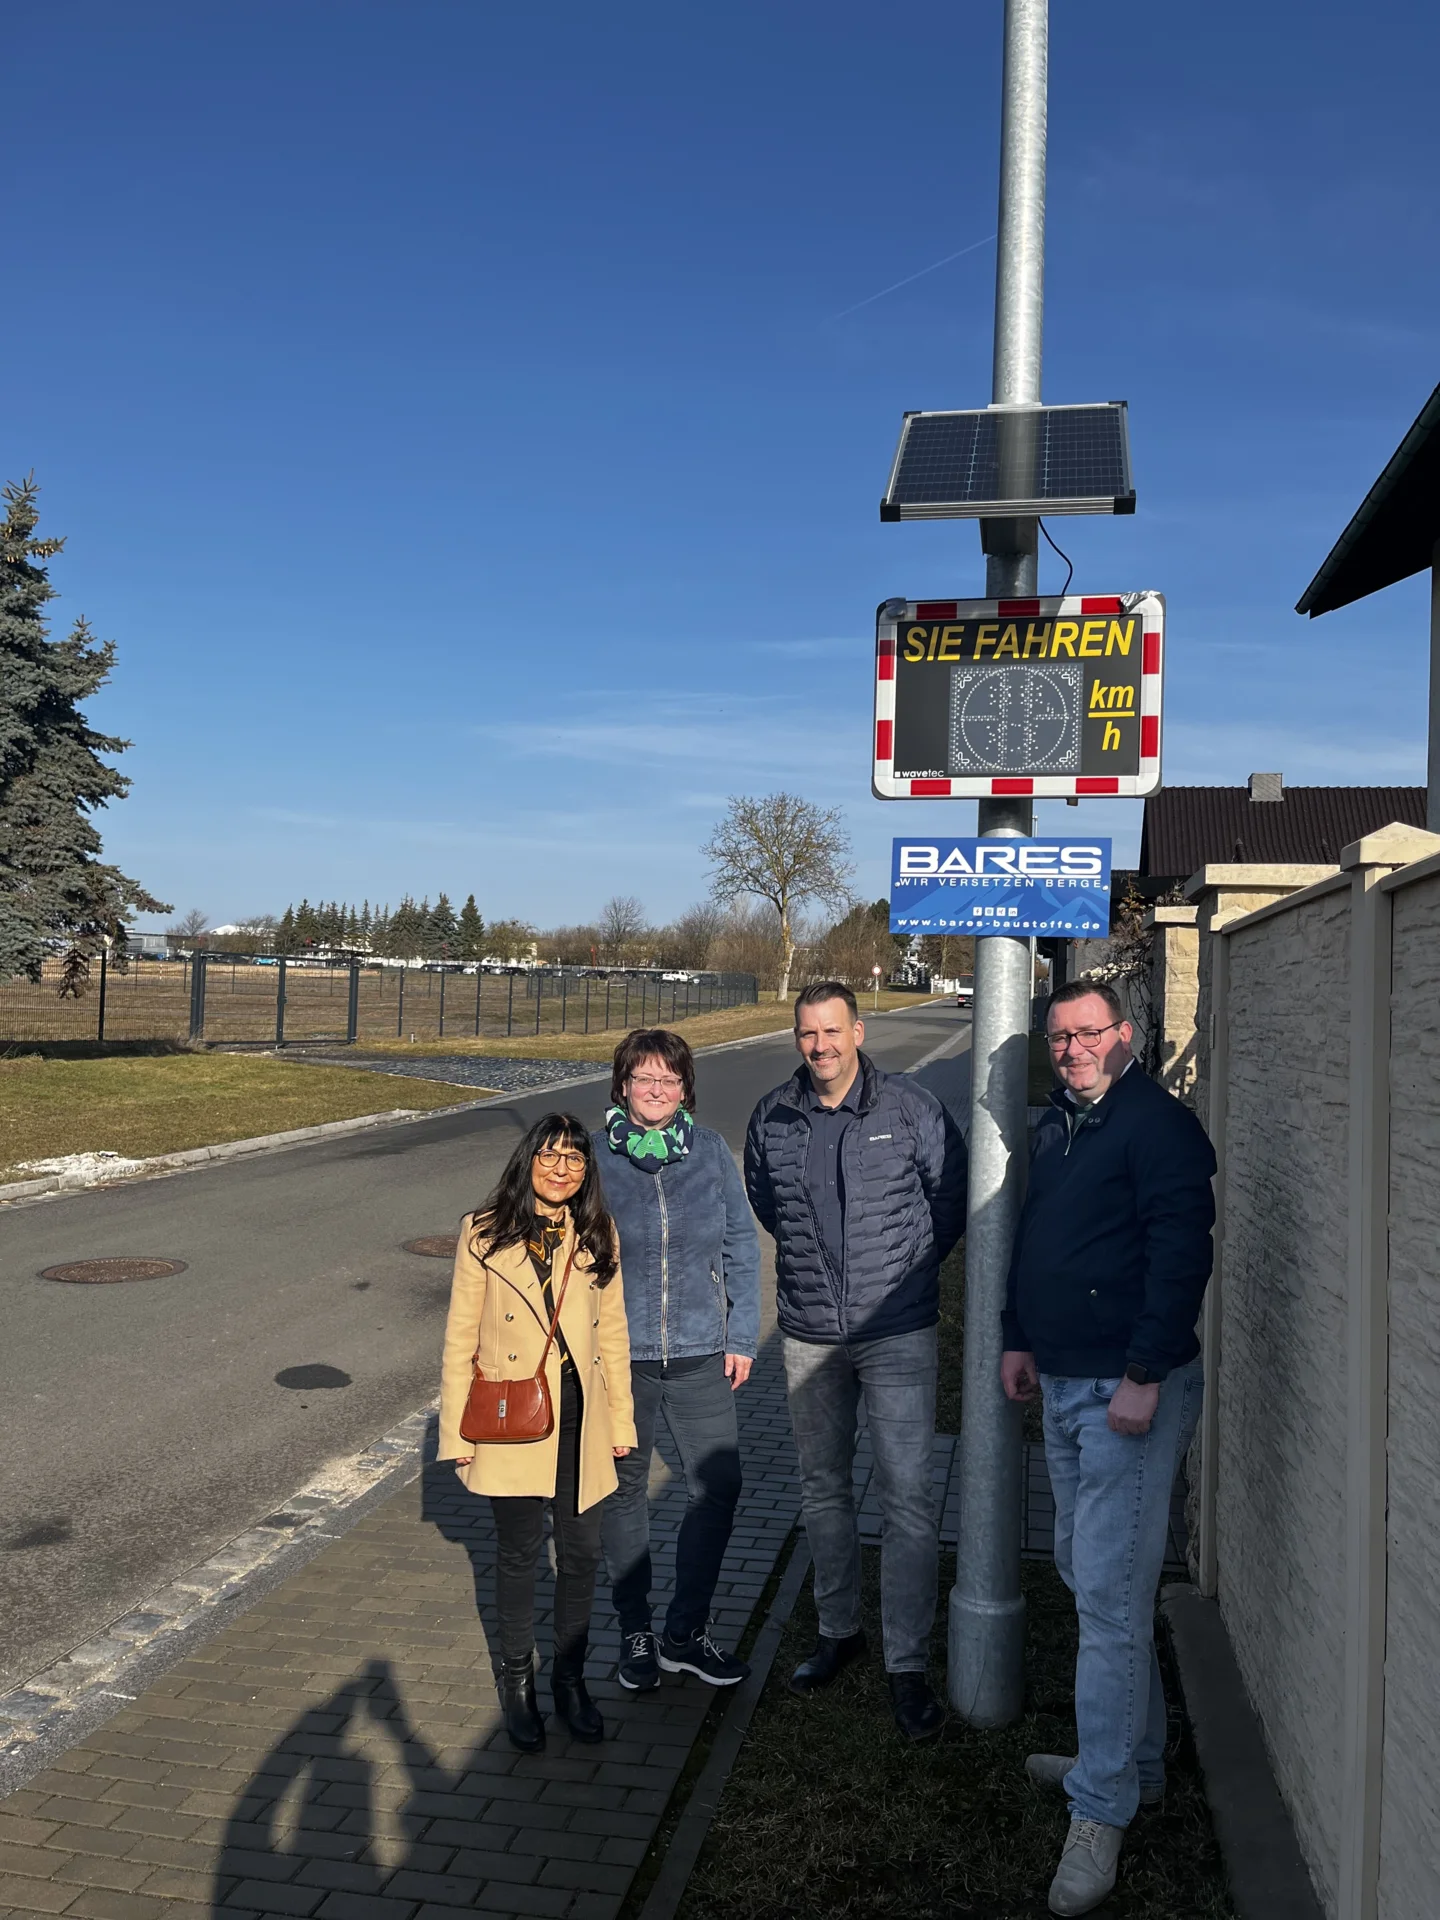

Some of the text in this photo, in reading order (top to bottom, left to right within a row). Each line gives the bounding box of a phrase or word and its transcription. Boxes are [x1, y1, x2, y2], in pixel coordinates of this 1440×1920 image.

[903, 620, 1136, 662] SIE FAHREN
[1089, 679, 1135, 709] km
[1102, 721, 1121, 751] h
[901, 768, 945, 779] wavetec
[900, 846, 1103, 874] BARES
[900, 878, 929, 887] WIR
[939, 878, 1034, 888] VERSETZEN
[898, 918, 1101, 930] www.bares-baustoffe.de
